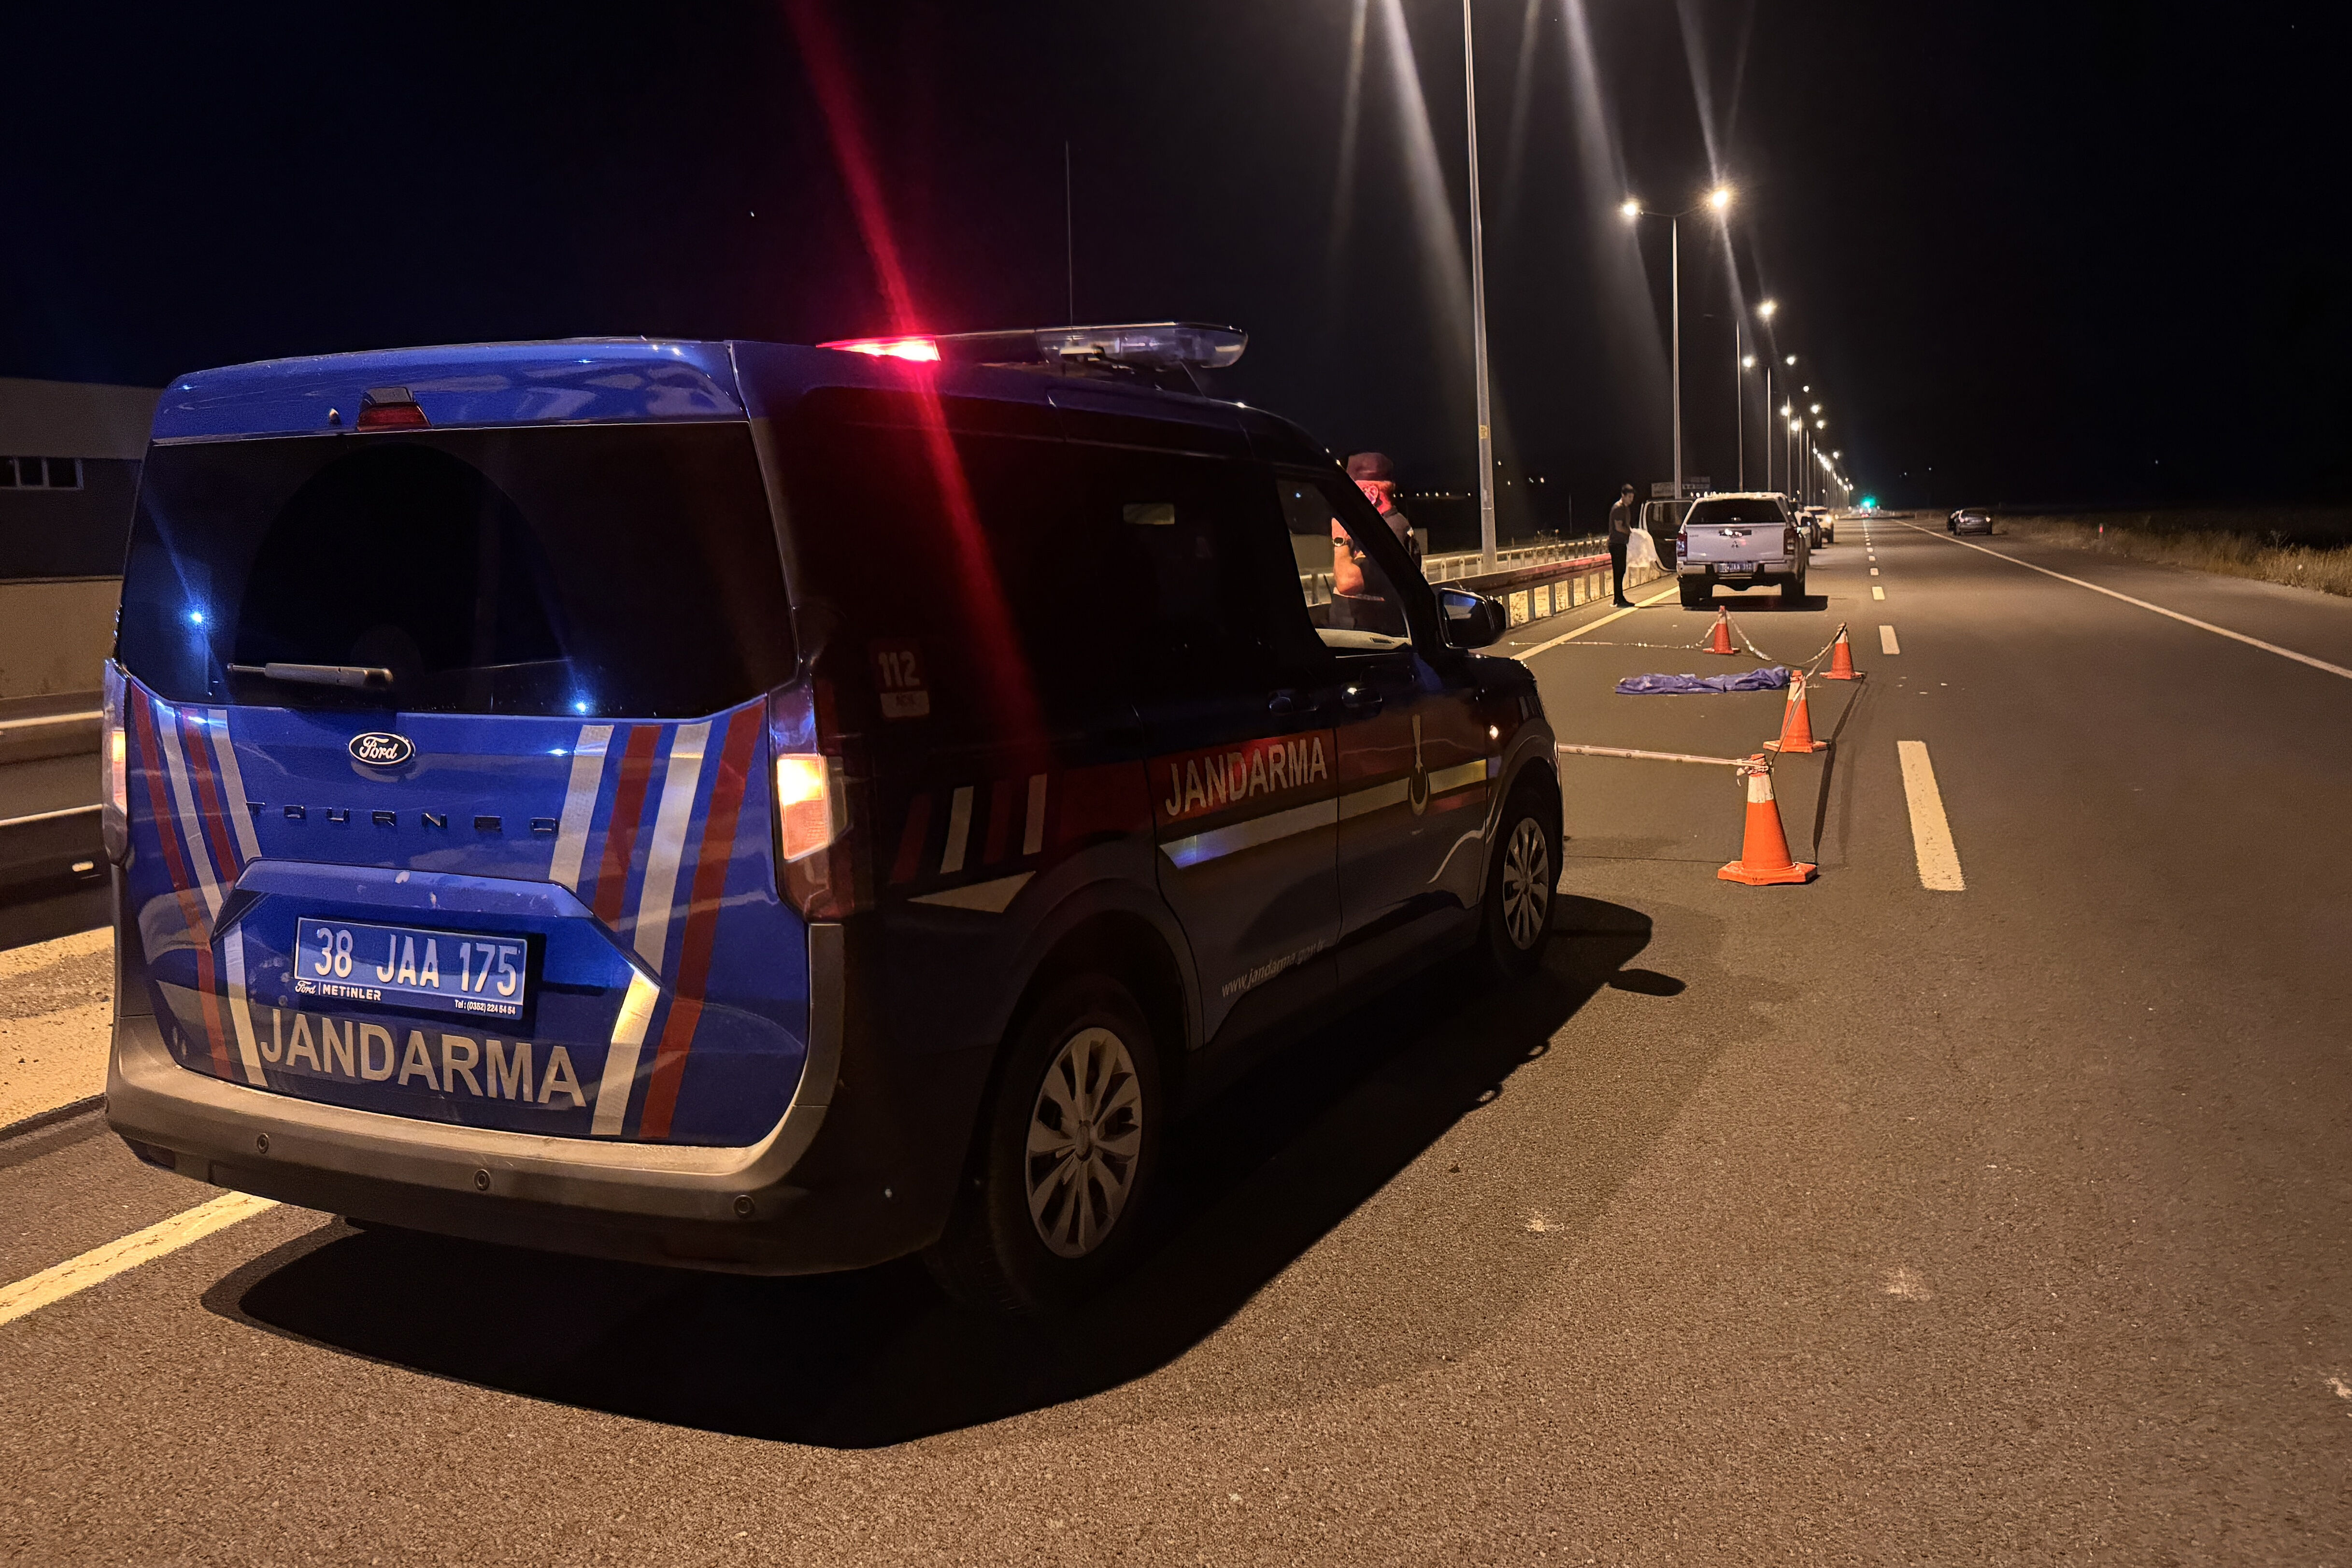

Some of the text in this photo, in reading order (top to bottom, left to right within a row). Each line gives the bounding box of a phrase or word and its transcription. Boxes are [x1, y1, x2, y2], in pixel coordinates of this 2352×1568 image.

[878, 651, 920, 687] 112
[359, 736, 398, 760] Ford
[1165, 737, 1328, 816] JANDARMA
[295, 980, 316, 994] Ford
[314, 927, 520, 997] 38 JAA 175
[260, 1009, 587, 1107] JANDARMA
